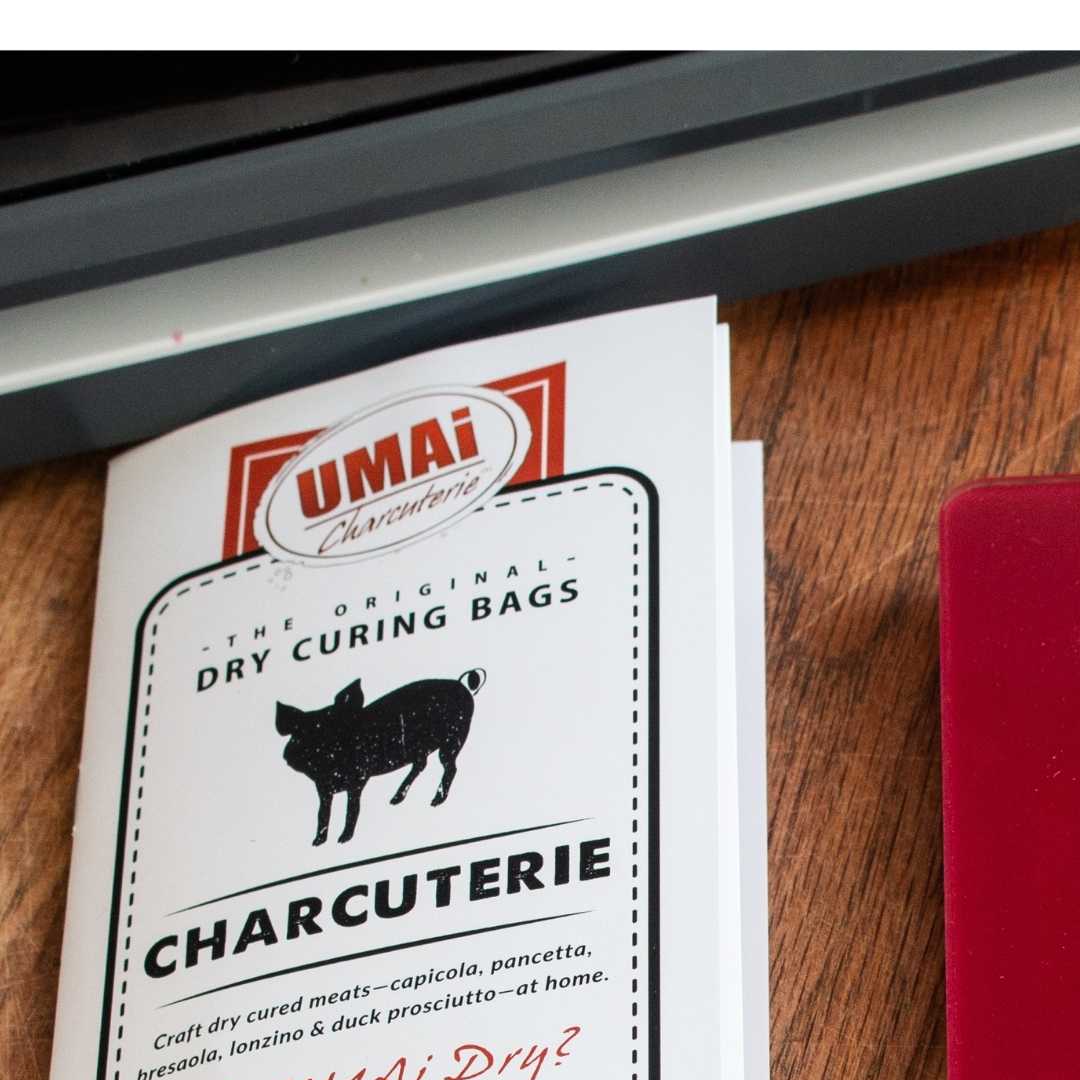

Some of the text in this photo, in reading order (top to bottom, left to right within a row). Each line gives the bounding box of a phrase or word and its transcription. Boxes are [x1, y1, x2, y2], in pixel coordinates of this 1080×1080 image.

[296, 406, 479, 519] UMAi
[318, 472, 479, 555] Charcuterie
[196, 578, 579, 693] DRY CURING BAGS
[143, 836, 611, 979] CHARCUTERIE
[153, 1023, 204, 1051] Craft
[207, 1014, 242, 1035] dry
[246, 995, 304, 1024] cured
[490, 943, 592, 976] pancetta,
[229, 1028, 305, 1057] lonzino
[330, 1008, 382, 1033] duck
[544, 970, 609, 992] home.
